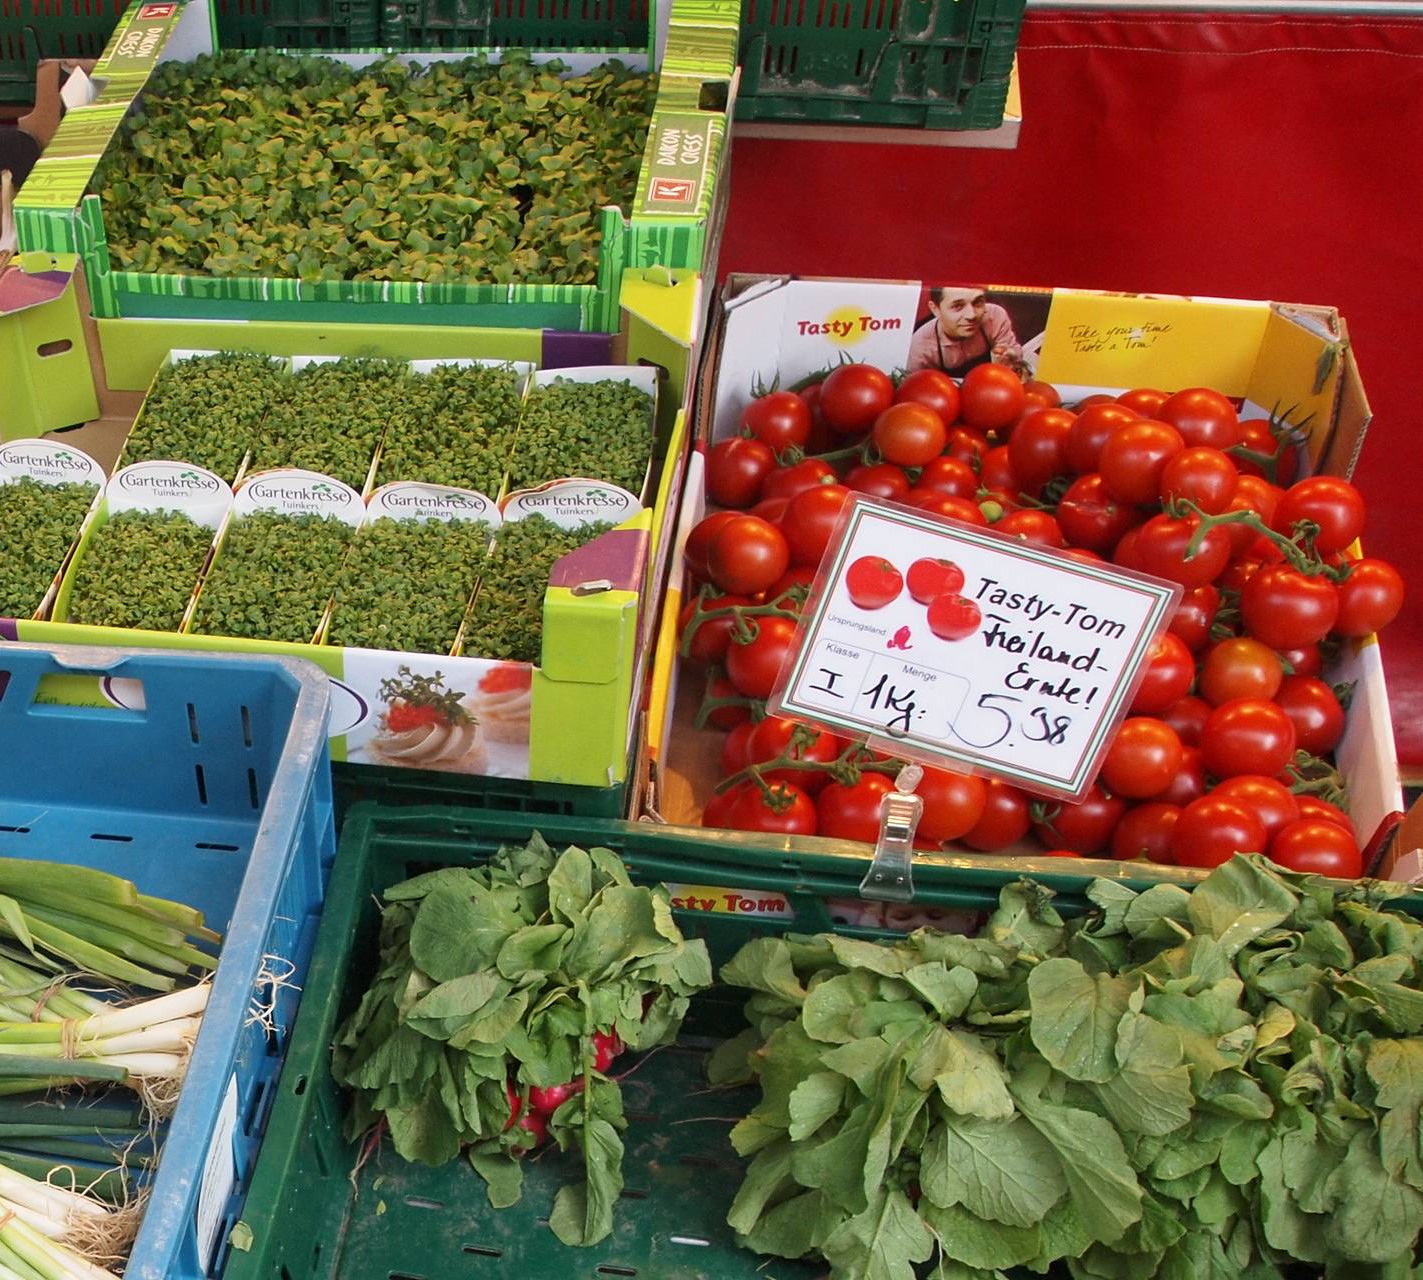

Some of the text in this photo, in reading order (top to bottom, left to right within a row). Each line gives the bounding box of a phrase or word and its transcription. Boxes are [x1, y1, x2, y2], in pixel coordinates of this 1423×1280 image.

[117, 31, 143, 56] CRESS
[136, 27, 163, 58] DAIKON
[657, 128, 681, 165] DAIKON
[680, 133, 704, 165] CRESS
[797, 316, 901, 337] Tasty Tom
[1069, 324, 1099, 338] Take
[1141, 322, 1173, 333] time
[1073, 339, 1104, 353] Taste
[1109, 343, 1117, 351] a
[3, 451, 89, 471] Gartenkresse
[29, 466, 63, 478] Tuinkers
[126, 473, 216, 490] Gartenkresse
[152, 488, 189, 498] Tuinkers
[254, 484, 348, 501] Gartenkresse
[525, 494, 625, 507] Gartenkresse
[283, 500, 319, 510] Tuinkers
[387, 493, 483, 510] Gartenkresse
[555, 507, 595, 515] Tuinkers
[976, 577, 1126, 640] Tasty-Tom
[827, 613, 887, 637] Ursprungsland
[825, 642, 937, 682] Klasse Menge
[671, 894, 786, 912] sty Tom
